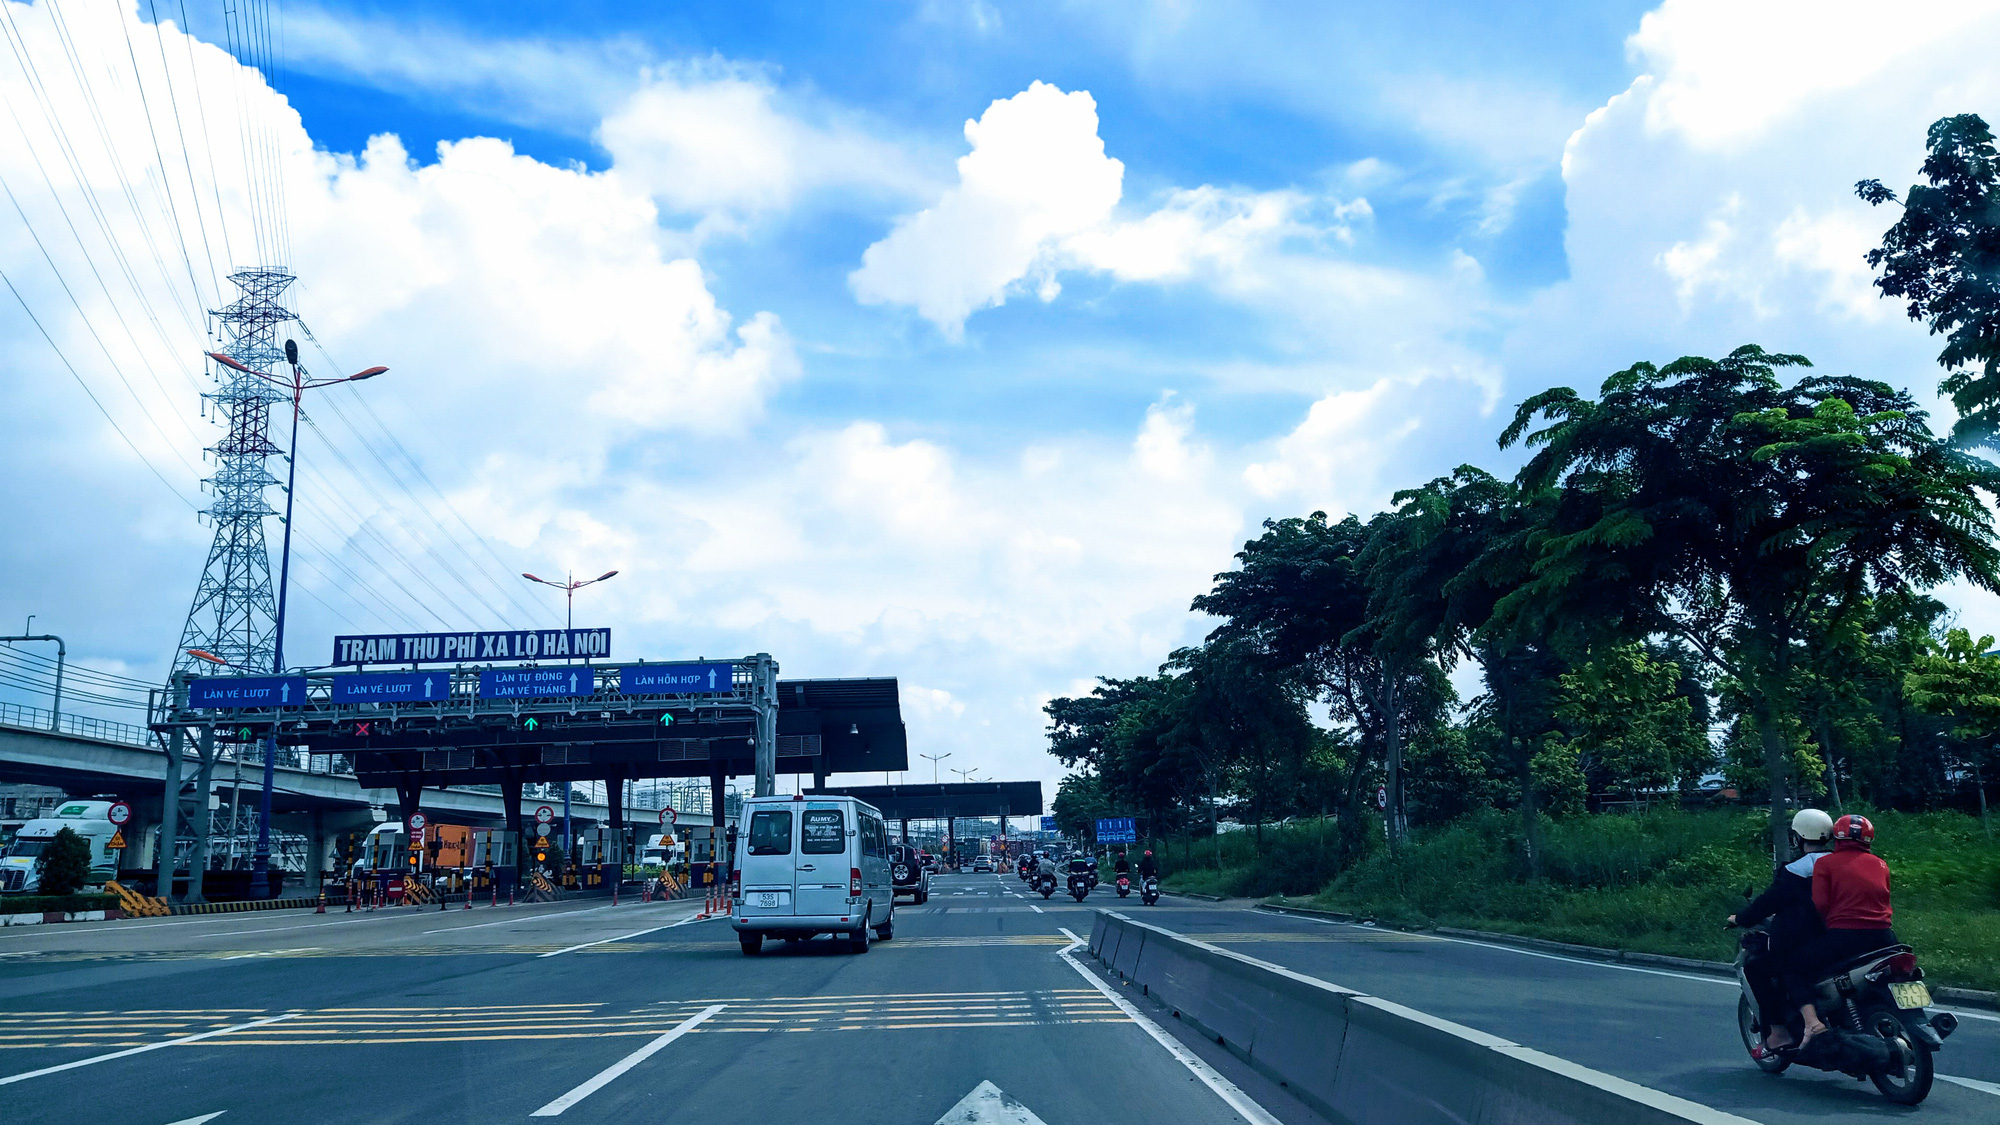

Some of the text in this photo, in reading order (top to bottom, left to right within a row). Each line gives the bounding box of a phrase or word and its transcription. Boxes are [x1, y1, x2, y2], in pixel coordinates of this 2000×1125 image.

[340, 629, 607, 664] TRẠM THU PHÍ XA LỘ HÀ NỘI
[494, 671, 563, 683] LÀN TỰ ĐỘNG
[635, 674, 655, 685] LÀN
[680, 674, 701, 686] HỢP
[203, 687, 270, 699] LÀN VÉ LƯỢT
[347, 683, 413, 695] LÀN VÉ LƯỢT
[495, 683, 566, 696] LÀN VÉ THÁNG
